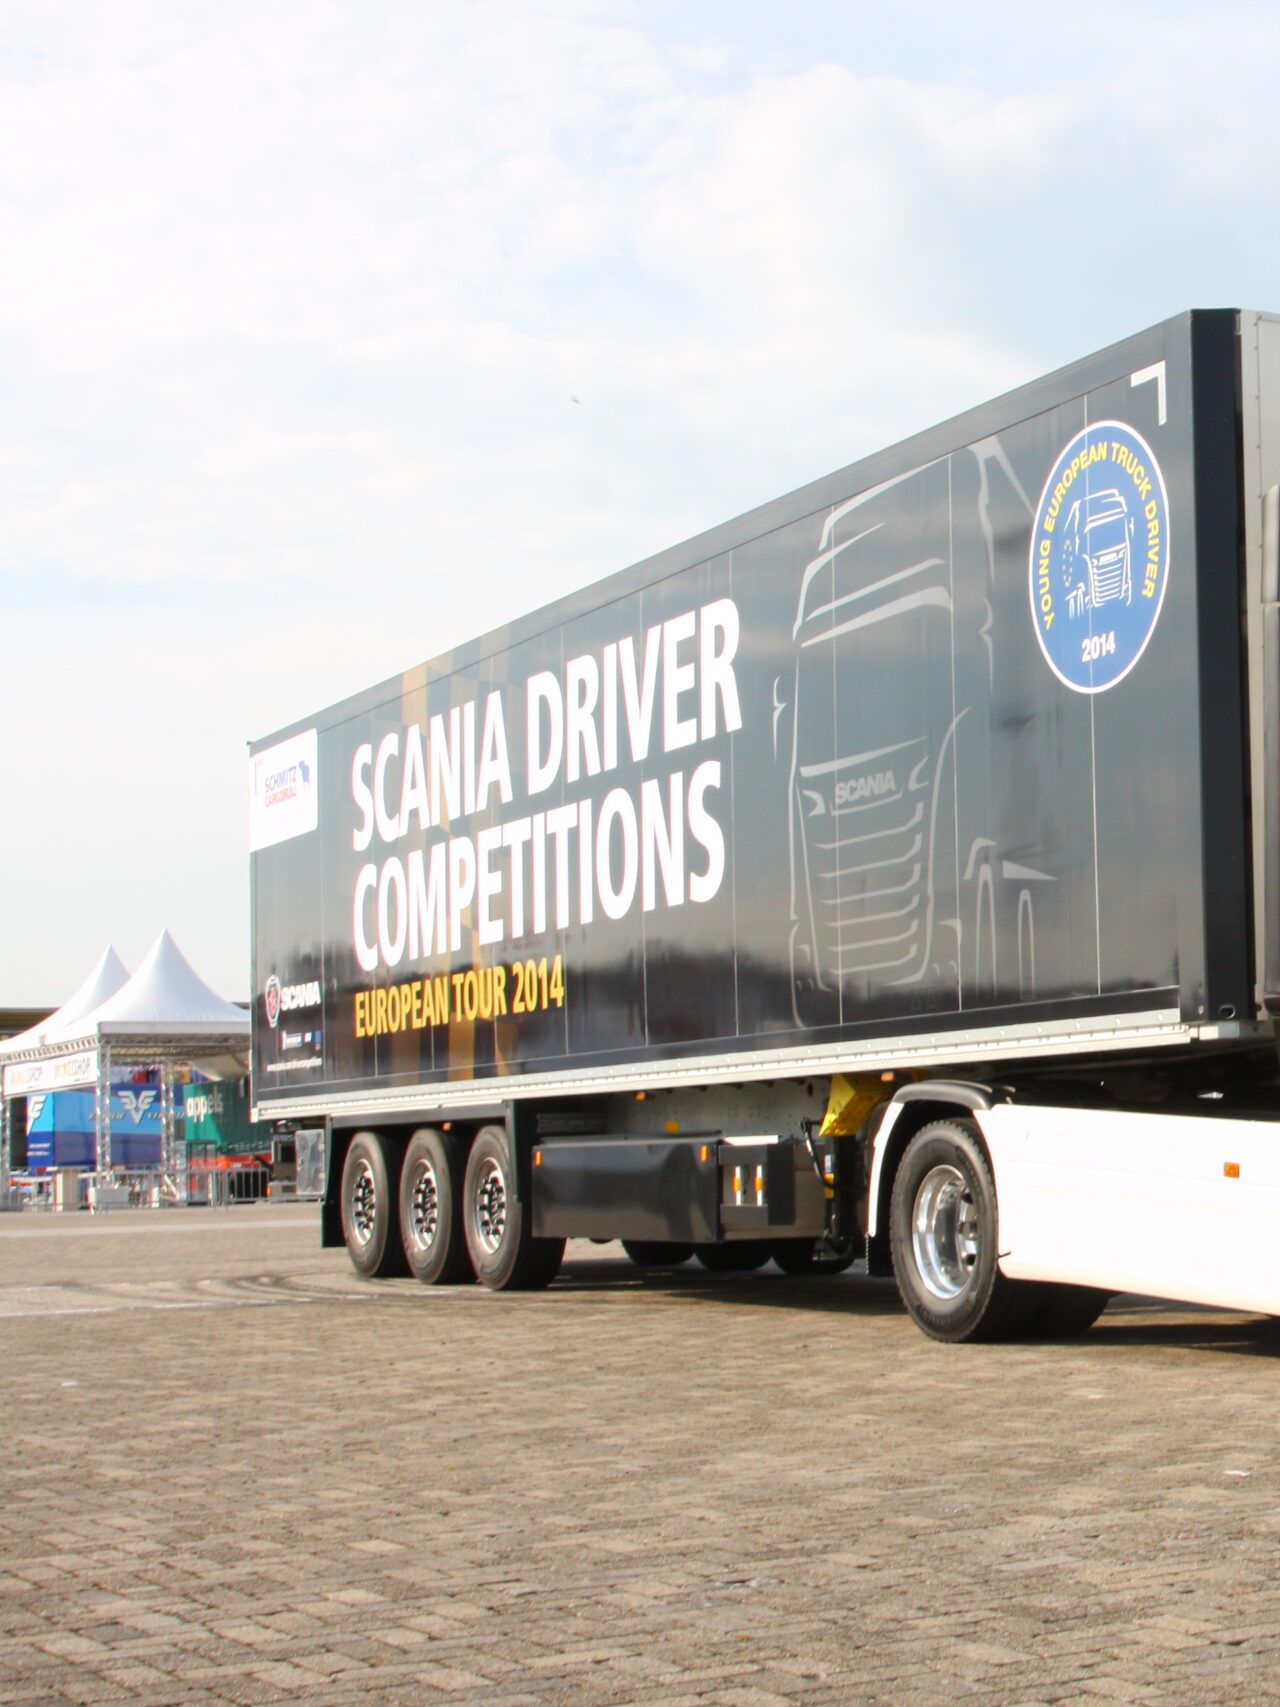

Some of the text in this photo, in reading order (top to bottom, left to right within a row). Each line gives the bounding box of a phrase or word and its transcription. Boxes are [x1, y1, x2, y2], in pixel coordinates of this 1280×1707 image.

[1039, 441, 1161, 630] YOUNG EUROPEAN TRUCK DRIVER
[1081, 631, 1116, 662] 2014
[351, 598, 743, 852] SCANIA DRIVER
[264, 765, 297, 794] SCHMITZ
[835, 770, 897, 805] SCANIA
[352, 761, 726, 972] COMPETITIONS
[280, 981, 321, 1011] SCANIA
[355, 954, 564, 1038] EUROPEAN TOUR 2014
